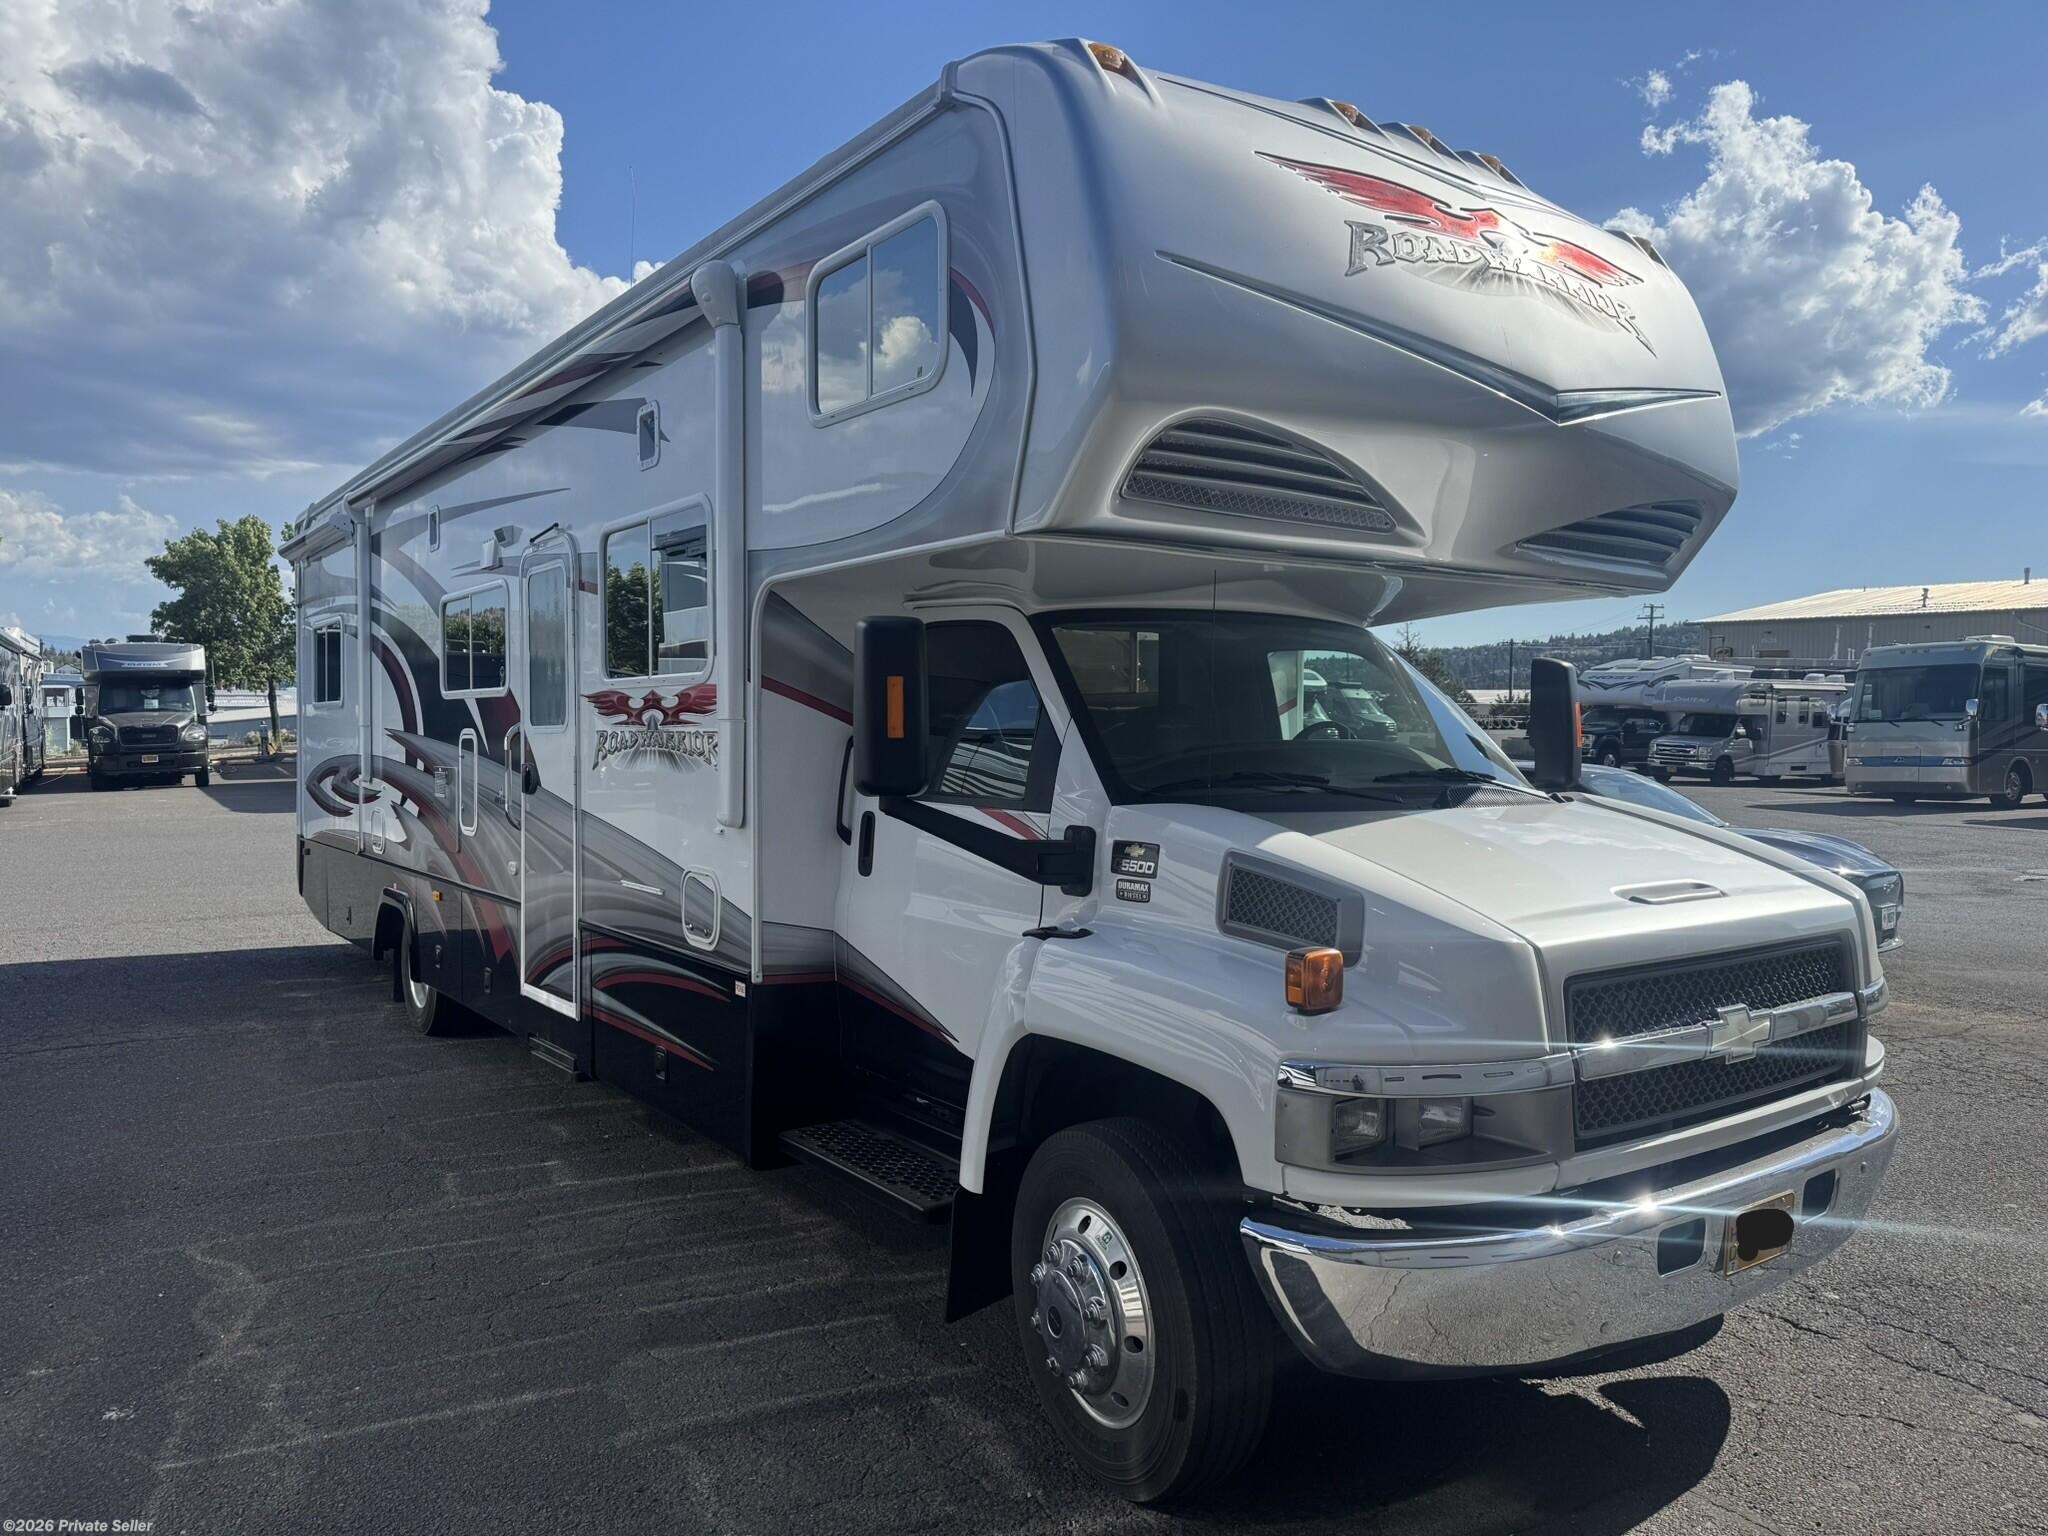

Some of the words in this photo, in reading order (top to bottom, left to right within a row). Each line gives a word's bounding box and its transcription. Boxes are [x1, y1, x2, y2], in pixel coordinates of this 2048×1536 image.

[1121, 859, 1155, 874] 5500
[1118, 881, 1149, 892] DURAMAX
[1124, 891, 1142, 900] DIESEL
